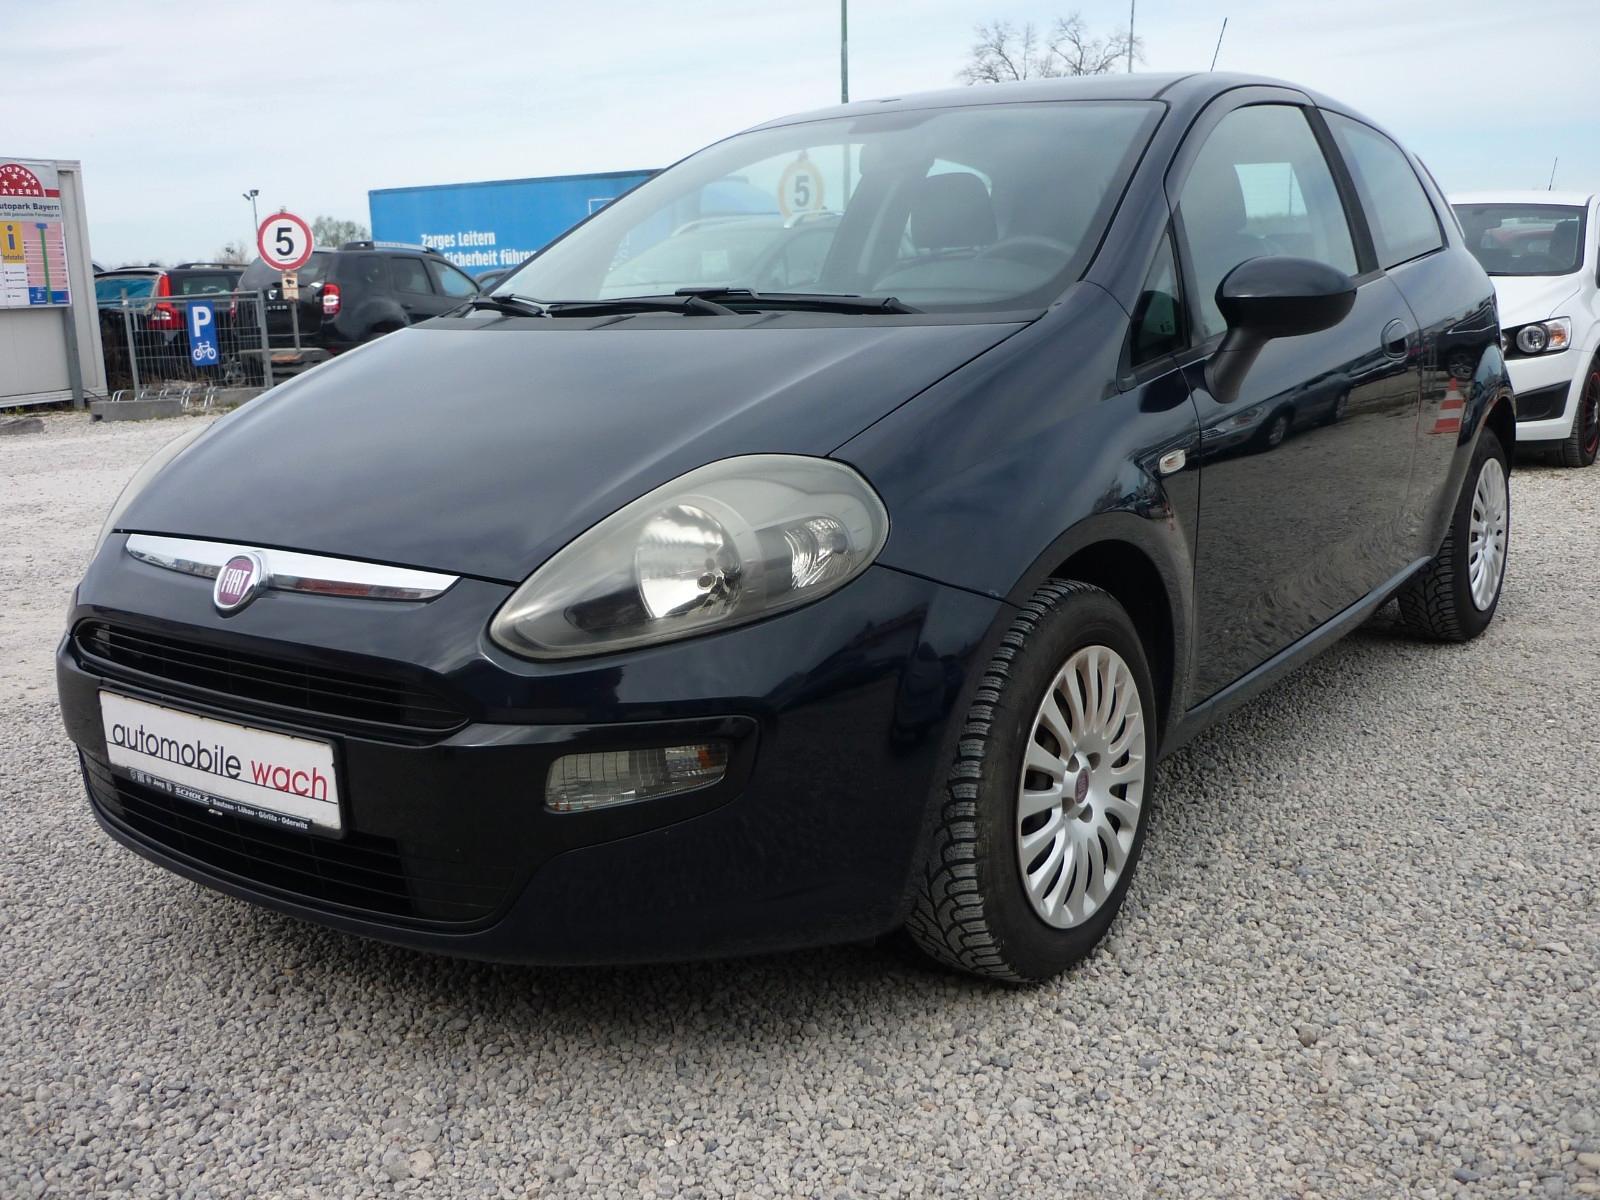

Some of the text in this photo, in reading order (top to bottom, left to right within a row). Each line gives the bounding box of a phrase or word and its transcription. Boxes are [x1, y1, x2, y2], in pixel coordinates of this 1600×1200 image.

[0, 166, 37, 186] TO PARK
[2, 188, 39, 196] AYERN
[794, 175, 810, 207] 5
[0, 202, 60, 212] utopark Bayern
[275, 226, 295, 257] 5
[421, 230, 496, 250] Zarges Leitern
[443, 249, 499, 268] Sicherheit
[192, 306, 211, 337] P
[220, 568, 251, 596] FIAT
[112, 723, 328, 801] automobile wach
[175, 786, 209, 803] SCHOLZ
[213, 798, 235, 811] Bautzen
[237, 805, 255, 817] Löbau
[258, 810, 278, 822] Görlitz
[281, 816, 309, 830] Oderwitz
